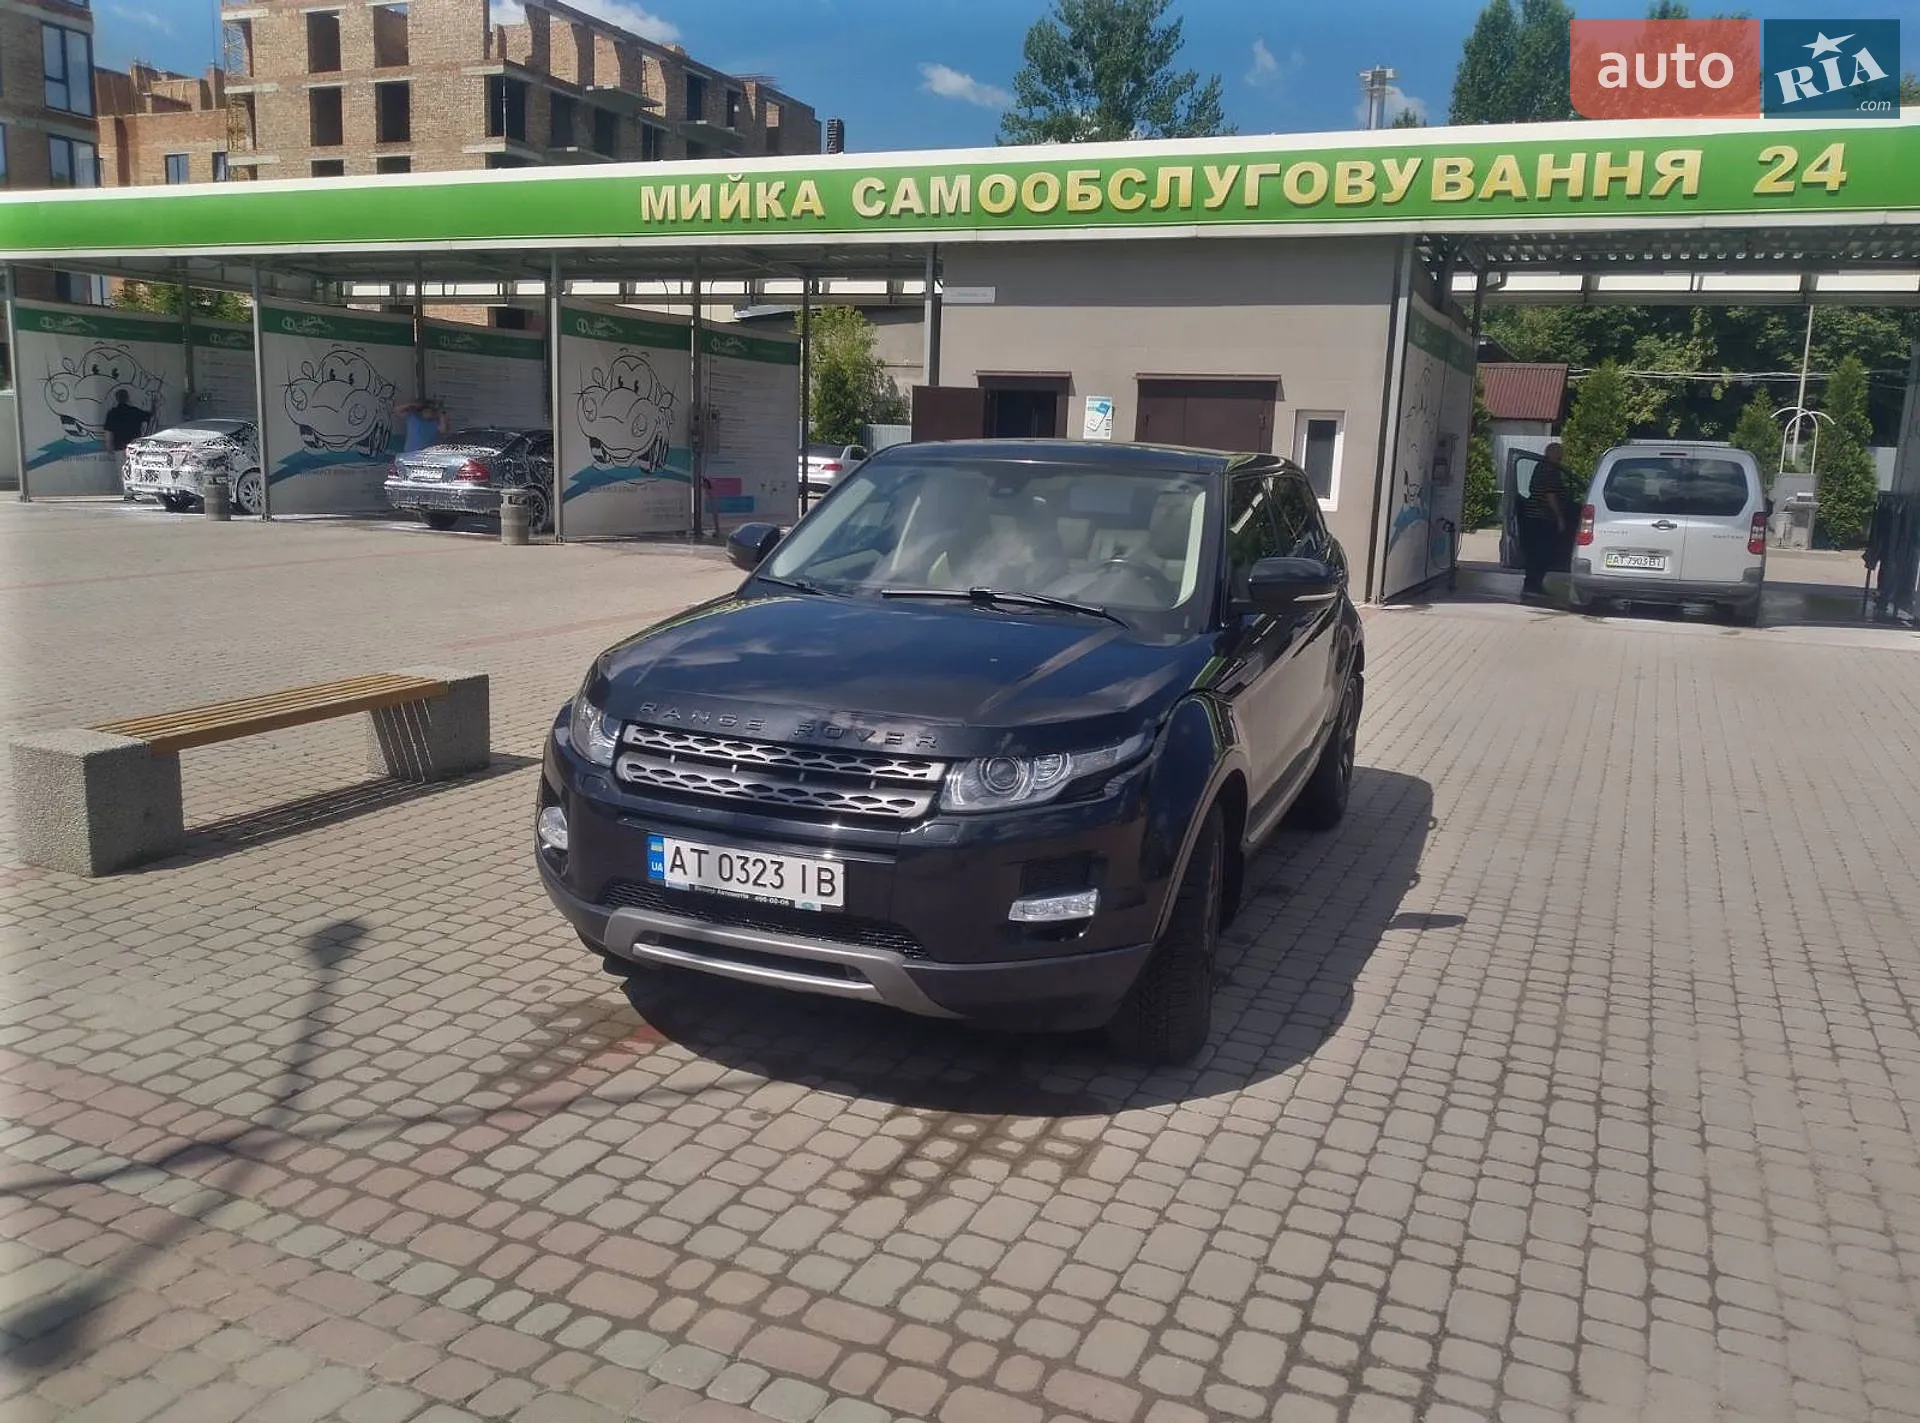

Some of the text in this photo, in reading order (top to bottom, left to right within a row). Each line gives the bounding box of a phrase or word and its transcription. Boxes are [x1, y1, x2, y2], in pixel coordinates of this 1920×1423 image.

[640, 141, 1848, 224] МИЙКА САМООБСЛУГОВУВАННЯ 24
[639, 702, 939, 749] RANGE ROVER
[651, 861, 664, 873] UA
[669, 846, 836, 897] AT 0323 IB
